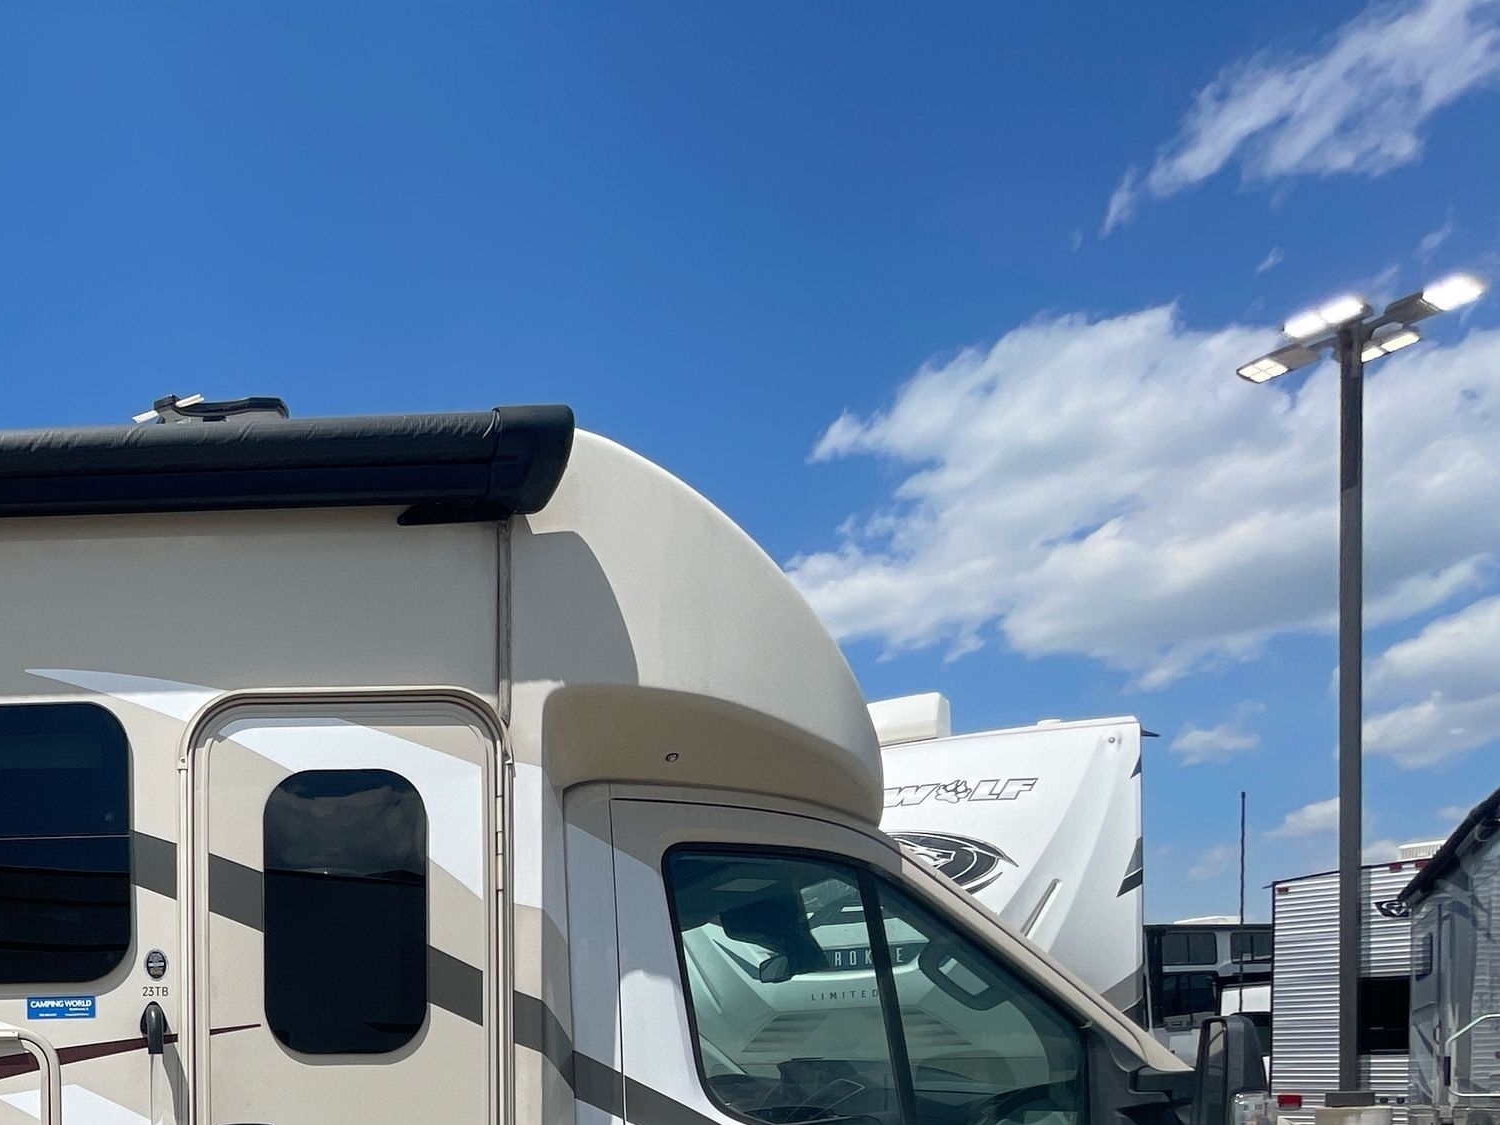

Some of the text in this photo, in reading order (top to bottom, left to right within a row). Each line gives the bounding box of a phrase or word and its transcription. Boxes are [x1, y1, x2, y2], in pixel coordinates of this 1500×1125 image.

[142, 986, 169, 997] 23TB
[810, 988, 880, 1001] LIMITED
[30, 999, 92, 1008] CAMPING WORLD
